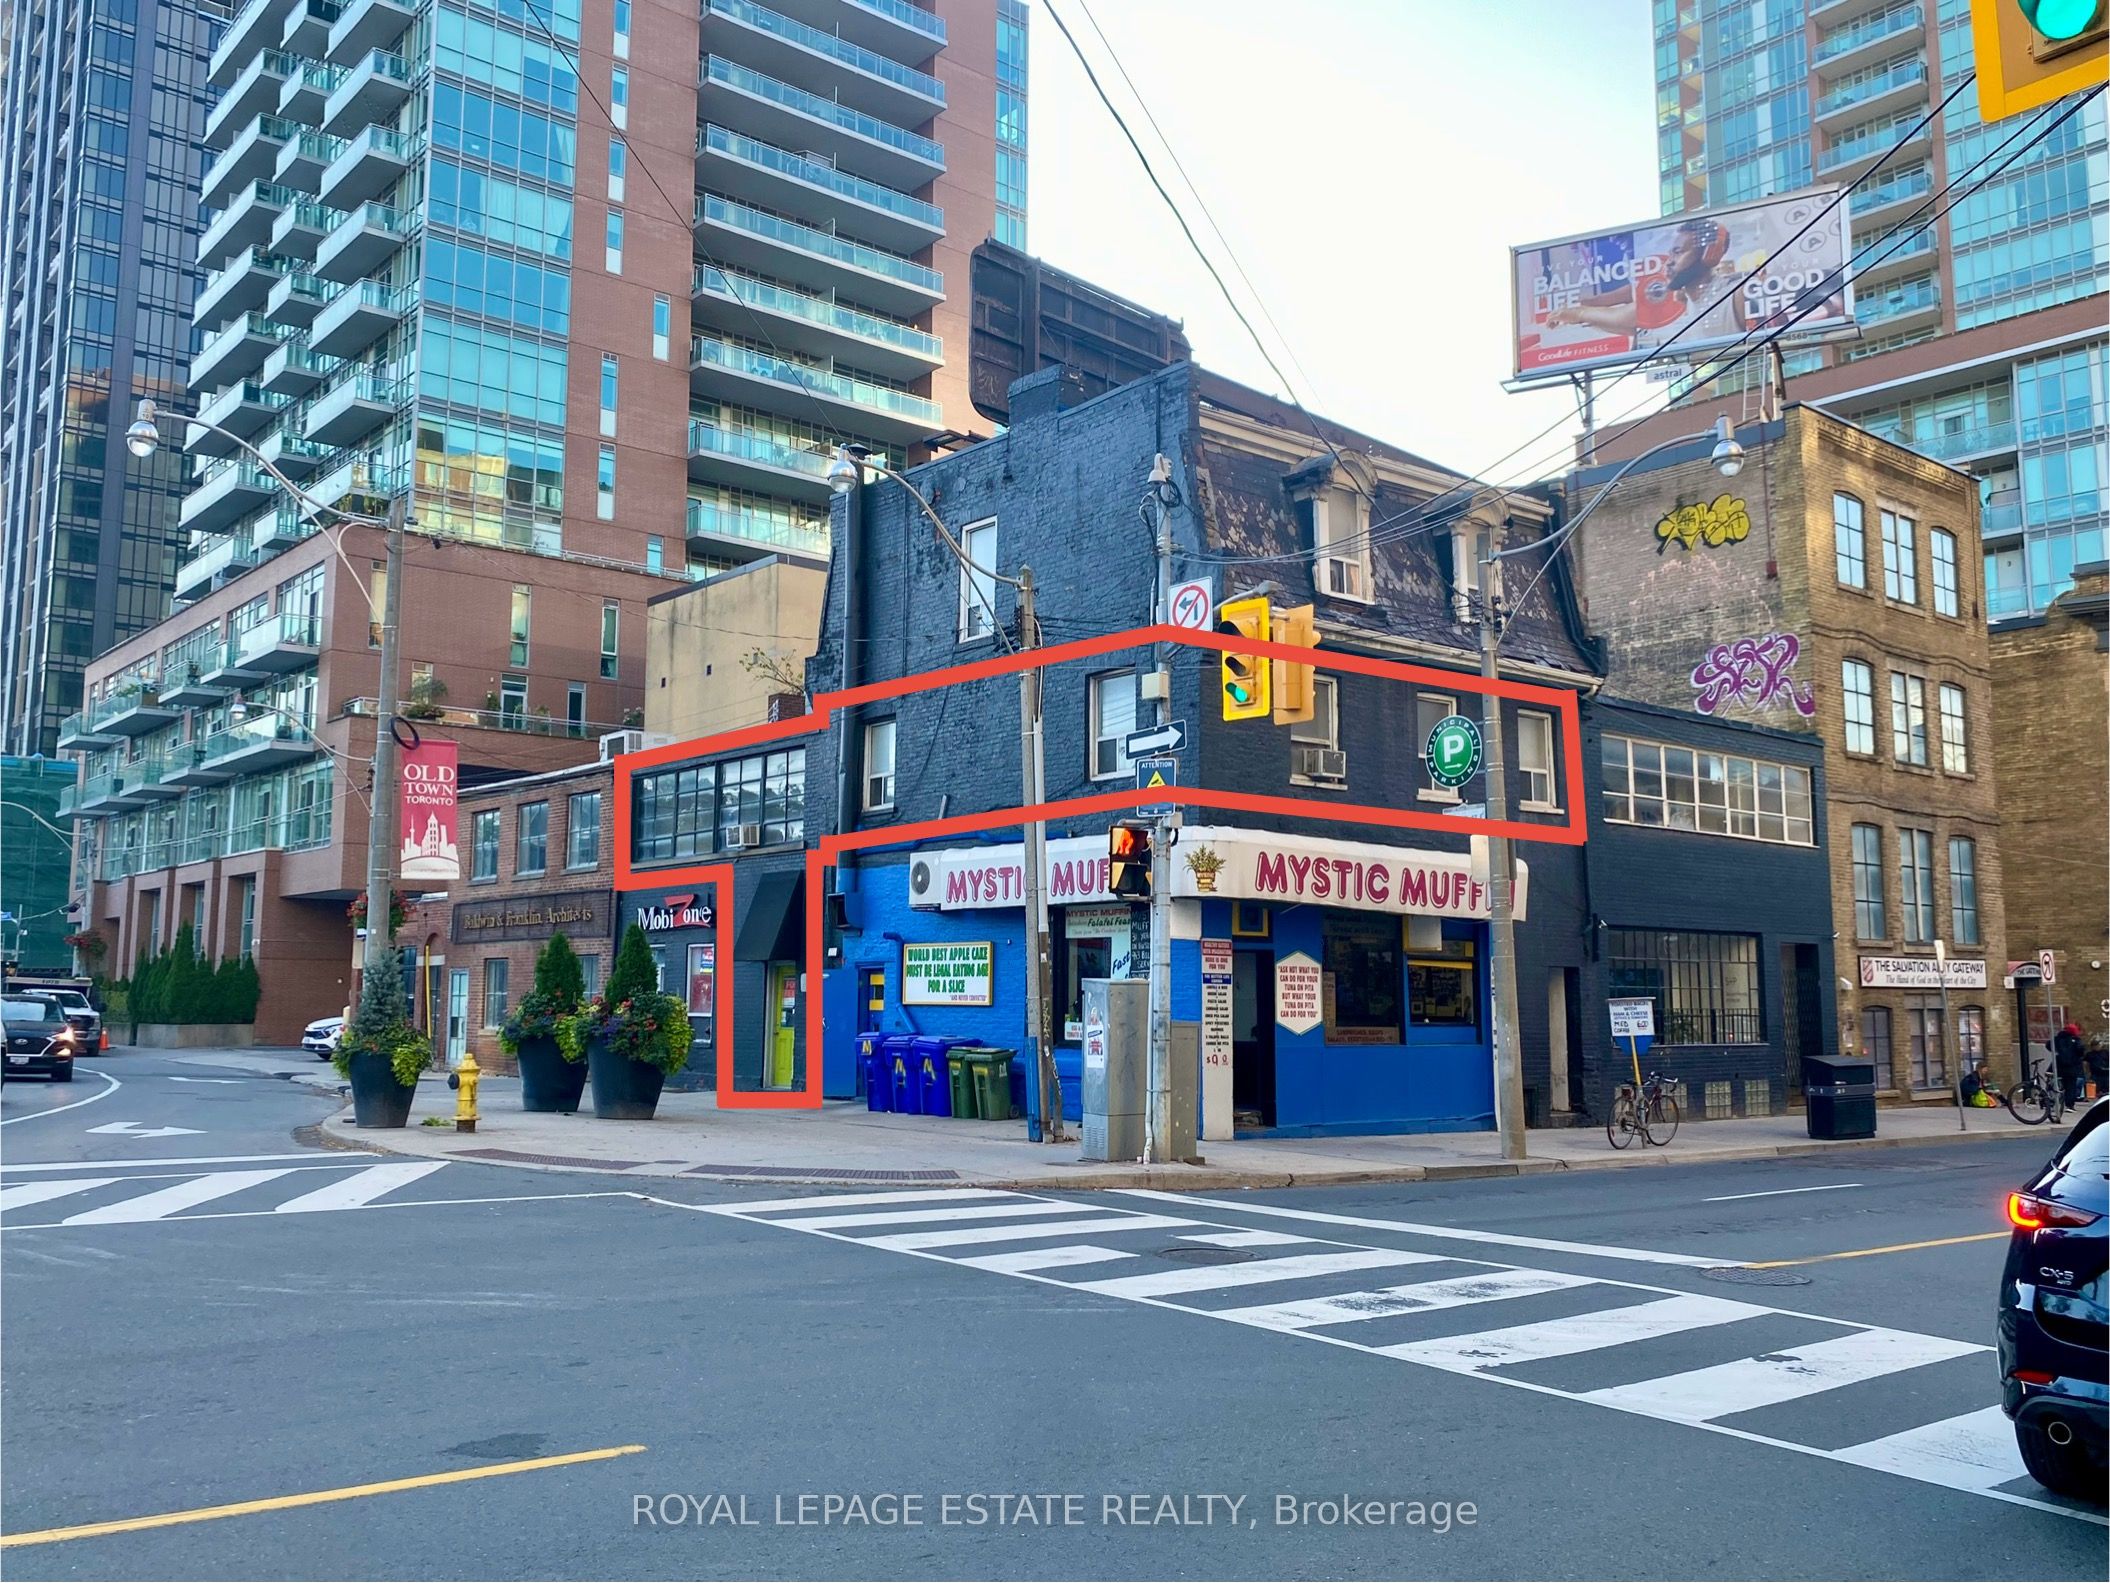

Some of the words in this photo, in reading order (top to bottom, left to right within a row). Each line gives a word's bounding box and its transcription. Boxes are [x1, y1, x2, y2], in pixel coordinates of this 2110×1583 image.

[1533, 256, 1662, 296] BALANCED
[1743, 268, 1825, 299] GOOD
[1534, 289, 1581, 314] LIFE
[1744, 293, 1798, 320] LIFE
[1574, 344, 1608, 356] FITNESS
[1654, 368, 1682, 380] astral
[1428, 719, 1478, 753] MUNICIPAL
[1443, 735, 1465, 763] P
[1141, 761, 1173, 769] ATTENTION
[1429, 754, 1478, 784] PARKING
[404, 763, 455, 782] OLD
[403, 782, 454, 796] TOWN
[405, 795, 454, 806] TORONTO
[946, 865, 1027, 903] MYSTI
[1051, 857, 1109, 897] MUF
[1254, 851, 1391, 904] MYSTIC
[546, 906, 592, 925] Architects
[637, 893, 712, 930] MobiZone
[1066, 909, 1098, 917] MYSTIC
[1087, 917, 1113, 927] Falafel
[1132, 921, 1150, 930] MUFF
[908, 948, 930, 961] WORLD
[932, 948, 947, 961] BEST
[949, 947, 970, 961] APPLE
[972, 946, 988, 960] CAKE
[906, 964, 923, 977] MUST
[924, 964, 932, 977] BE
[933, 963, 952, 977] LEGAL
[952, 963, 975, 977] EATING
[976, 963, 989, 977] AGE
[1112, 951, 1130, 975] Fast
[1875, 960, 1890, 972] THE
[1892, 960, 1930, 973] SALVATION
[1931, 962, 1951, 973] AY
[1952, 962, 1984, 974] GATEWAY
[1289, 966, 1297, 974] NOT
[1299, 967, 1310, 975] WHAT
[1311, 967, 1319, 975] YOU
[1280, 974, 1288, 982] CAN
[1297, 975, 1305, 983] FOR
[1307, 975, 1318, 983] YOUR
[1886, 974, 1895, 984] The
[1911, 975, 1916, 985] of
[1917, 975, 1926, 984] God
[1967, 977, 1977, 985] City
[928, 979, 941, 993] FOR
[942, 979, 947, 993] A
[948, 979, 965, 993] SLICE
[1282, 992, 1291, 1000] BUT
[1280, 1010, 1289, 1018] CAN
[1290, 1010, 1297, 1018] DO
[1297, 1010, 1306, 1018] FOR
[2039, 1266, 2074, 1280] CX-5
